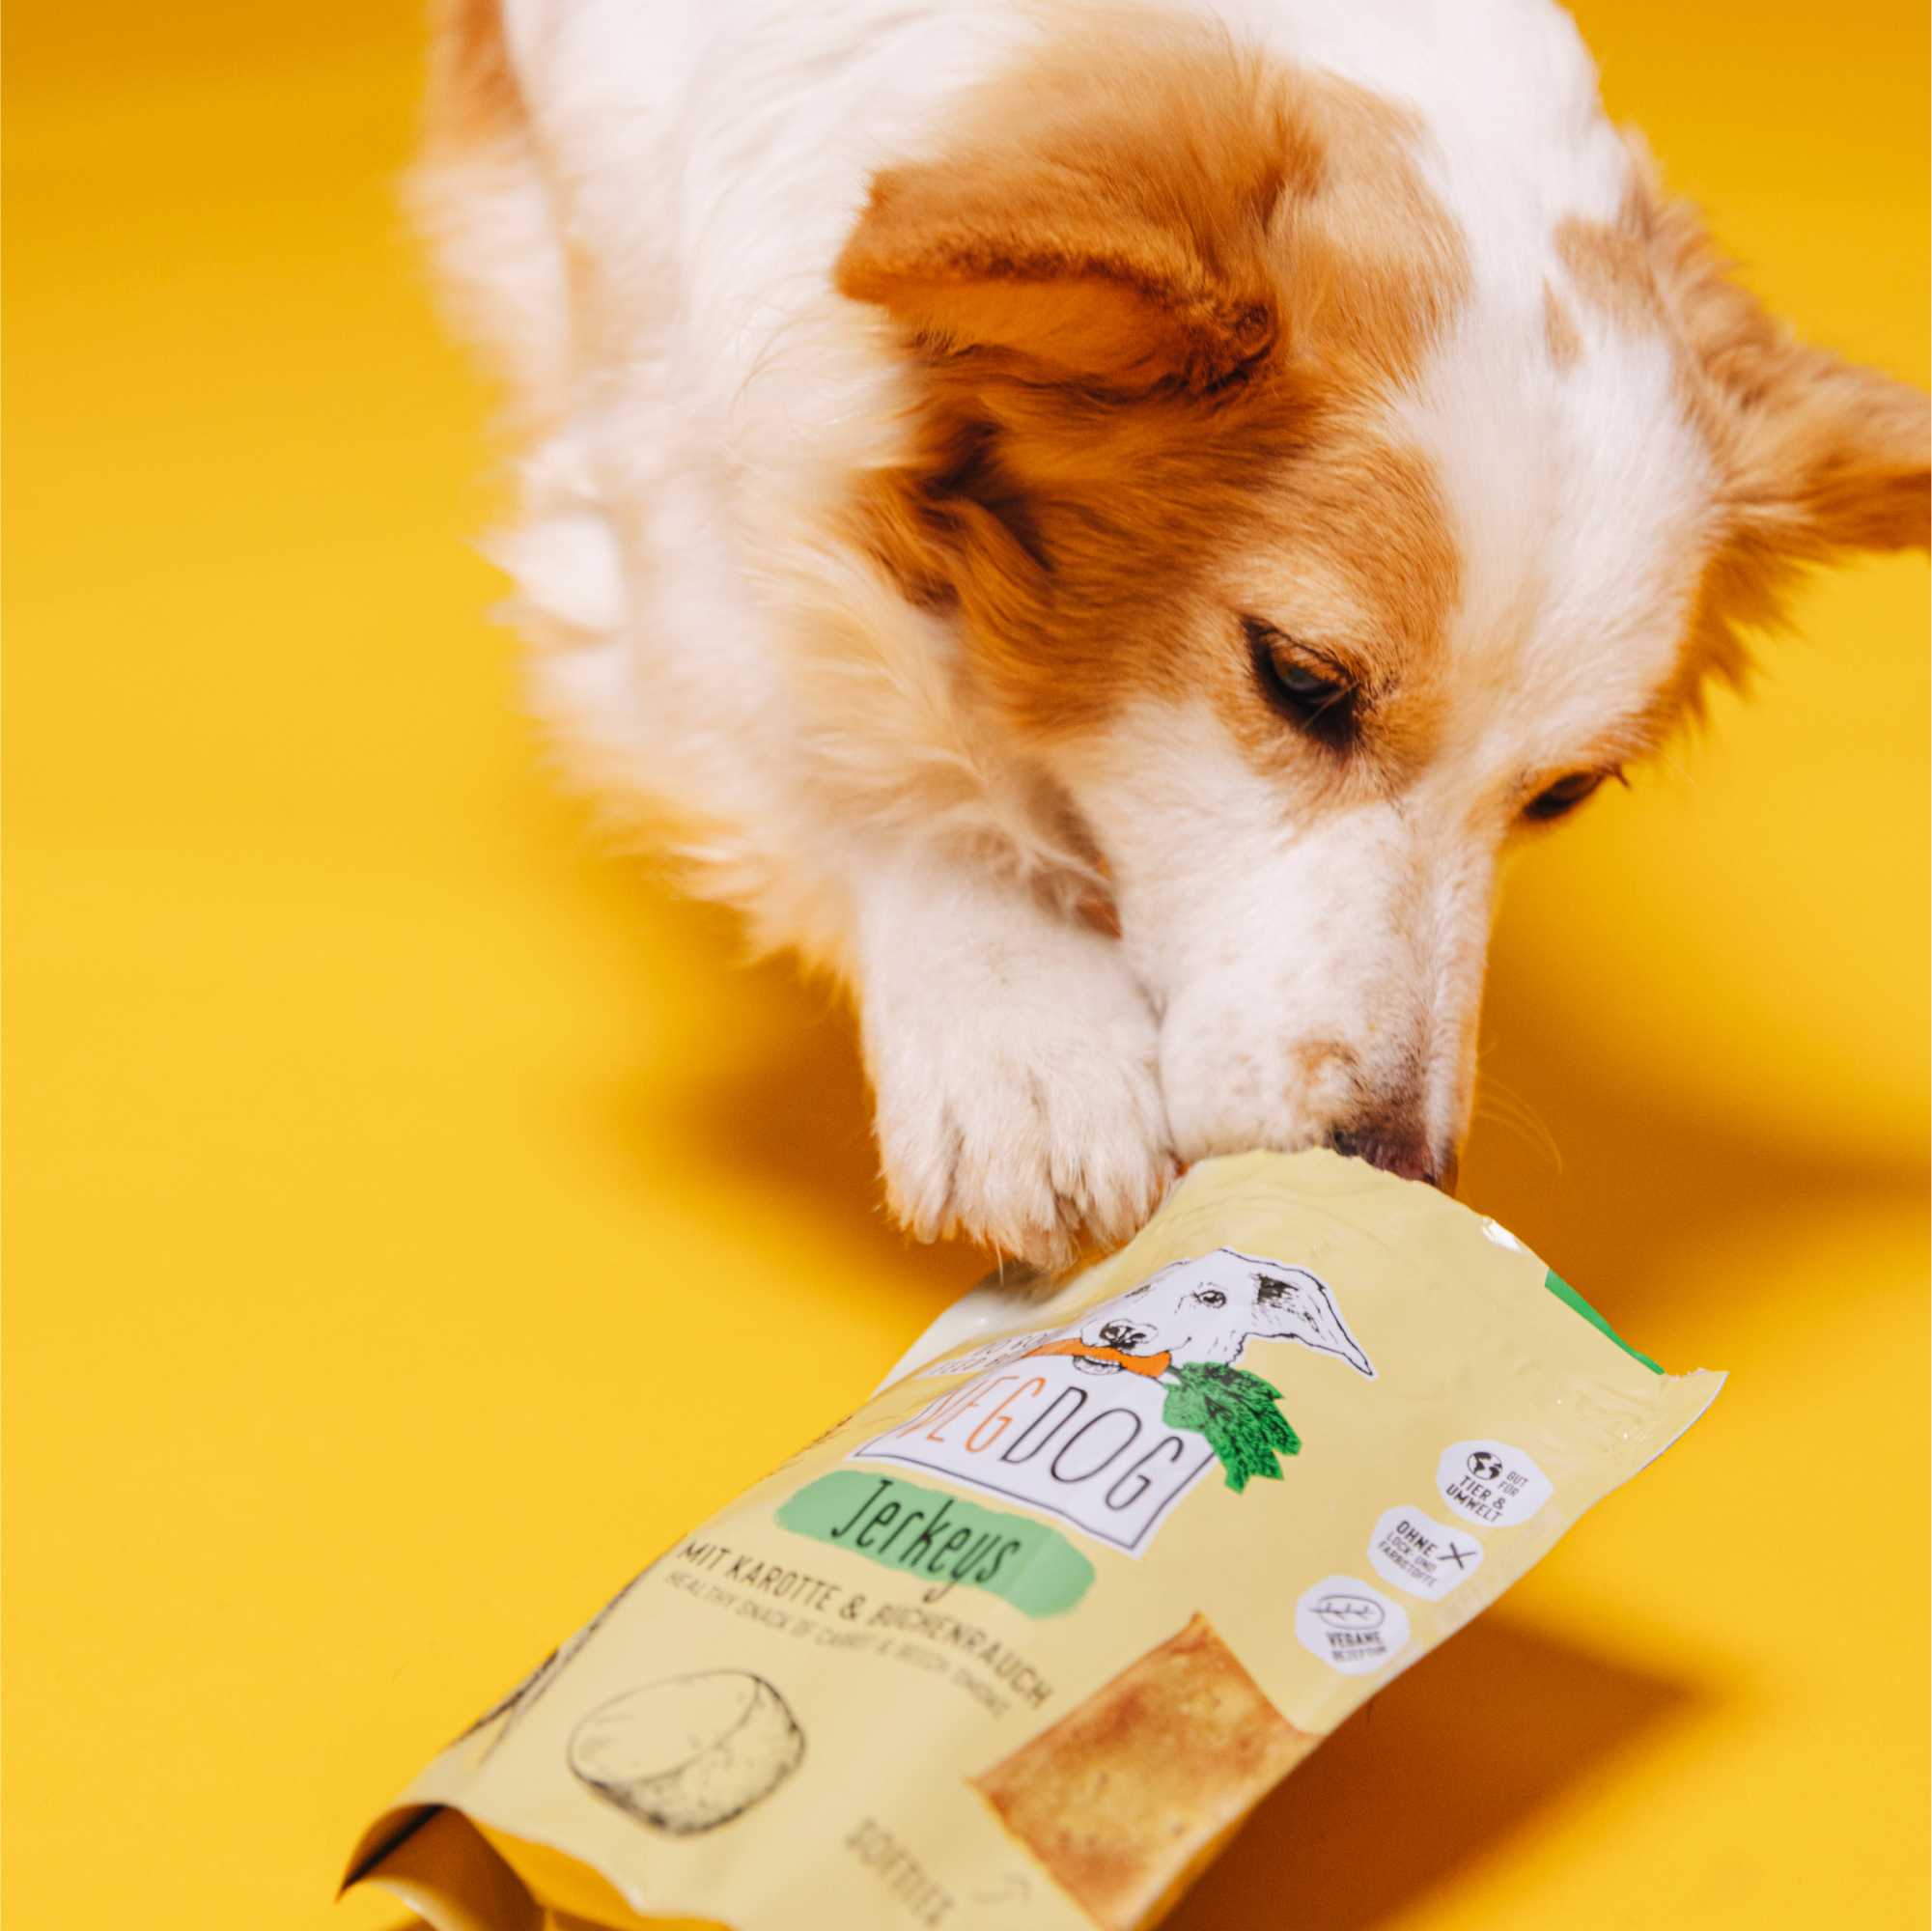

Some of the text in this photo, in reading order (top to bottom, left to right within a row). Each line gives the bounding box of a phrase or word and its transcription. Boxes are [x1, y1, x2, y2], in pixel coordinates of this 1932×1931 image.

[1446, 1483, 1503, 1524] UMWELT
[1459, 1475, 1507, 1510] TIER &
[830, 1477, 1022, 1603] Jerkeys
[1396, 1520, 1438, 1556] OHNE
[677, 1540, 1053, 1708] MIT KAROTTE & BUCHENRAUCH
